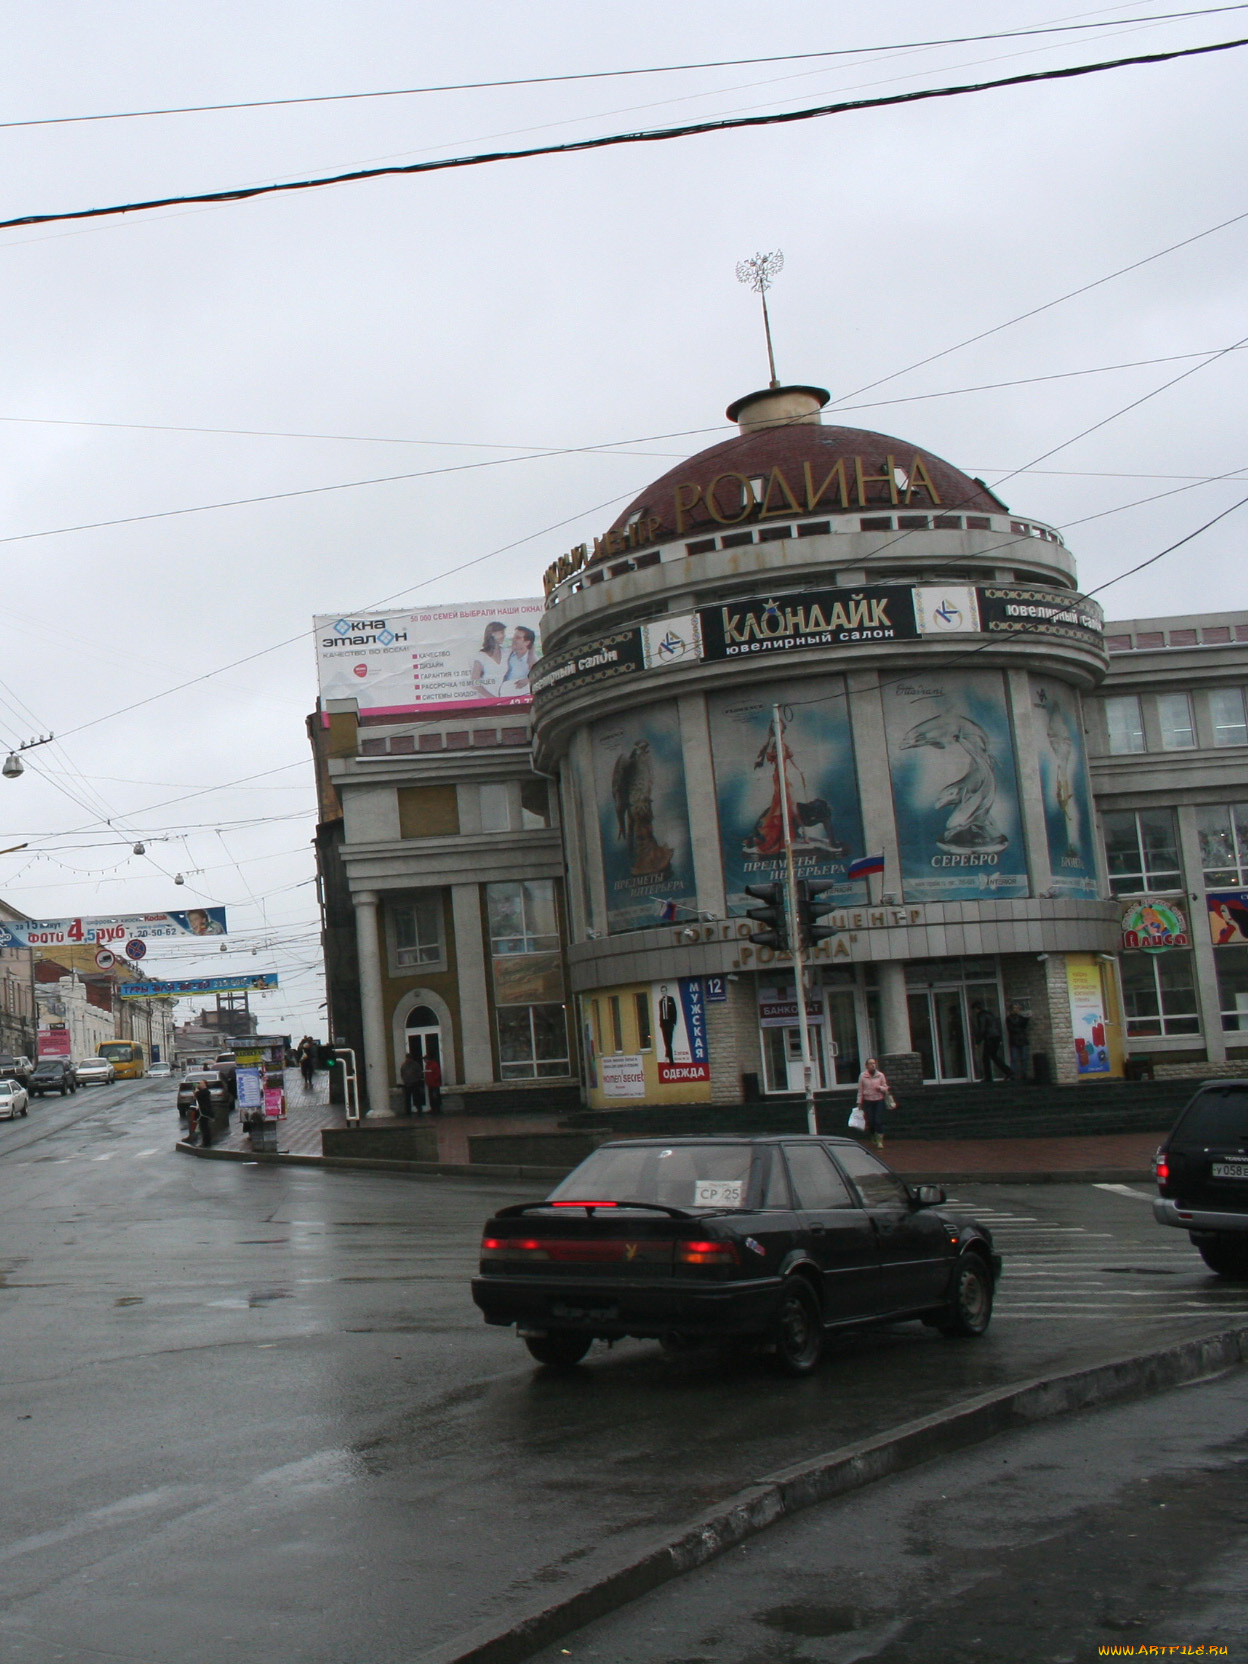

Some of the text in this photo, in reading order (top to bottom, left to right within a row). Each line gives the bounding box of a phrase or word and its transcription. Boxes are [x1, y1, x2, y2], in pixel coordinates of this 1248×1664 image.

[676, 453, 941, 534] РОДИНА
[433, 612, 458, 621] СЕМЕЙ
[460, 609, 496, 618] ВЫБРАЛИ
[498, 607, 520, 615] НАШИ
[521, 605, 543, 613] ОКНА!
[1006, 604, 1078, 624] ювелирный
[725, 629, 894, 655] ювелирный салон
[322, 650, 366, 659] КАЧЕСТВО
[418, 651, 451, 659] КАЧЕСТВО
[578, 648, 619, 671] салон
[419, 661, 444, 670] ДИЗАЙН
[420, 671, 452, 680] ГАРАНТИЯ
[421, 681, 458, 690] РАССРОЧКА
[422, 690, 477, 700] СИСТЕМЫ СКИДОК
[743, 855, 817, 873] ПРЕДМТЫ
[931, 853, 998, 868] СЕРЕБРО
[770, 864, 846, 880] ИНЕРЬЕРА
[143, 914, 168, 922] Kodak
[831, 910, 921, 929] ЦЕНТР
[25, 921, 38, 930] 15
[27, 932, 65, 944] ФОТО
[137, 927, 177, 938] 20-50-62
[1125, 930, 1187, 948] Алиса
[708, 979, 722, 993] 12
[763, 1003, 819, 1016] БАНКОАТ
[689, 982, 704, 1058] МУЖСКАЯ
[663, 1067, 705, 1079] ОДЕЖДА
[724, 1188, 739, 1199] 25
